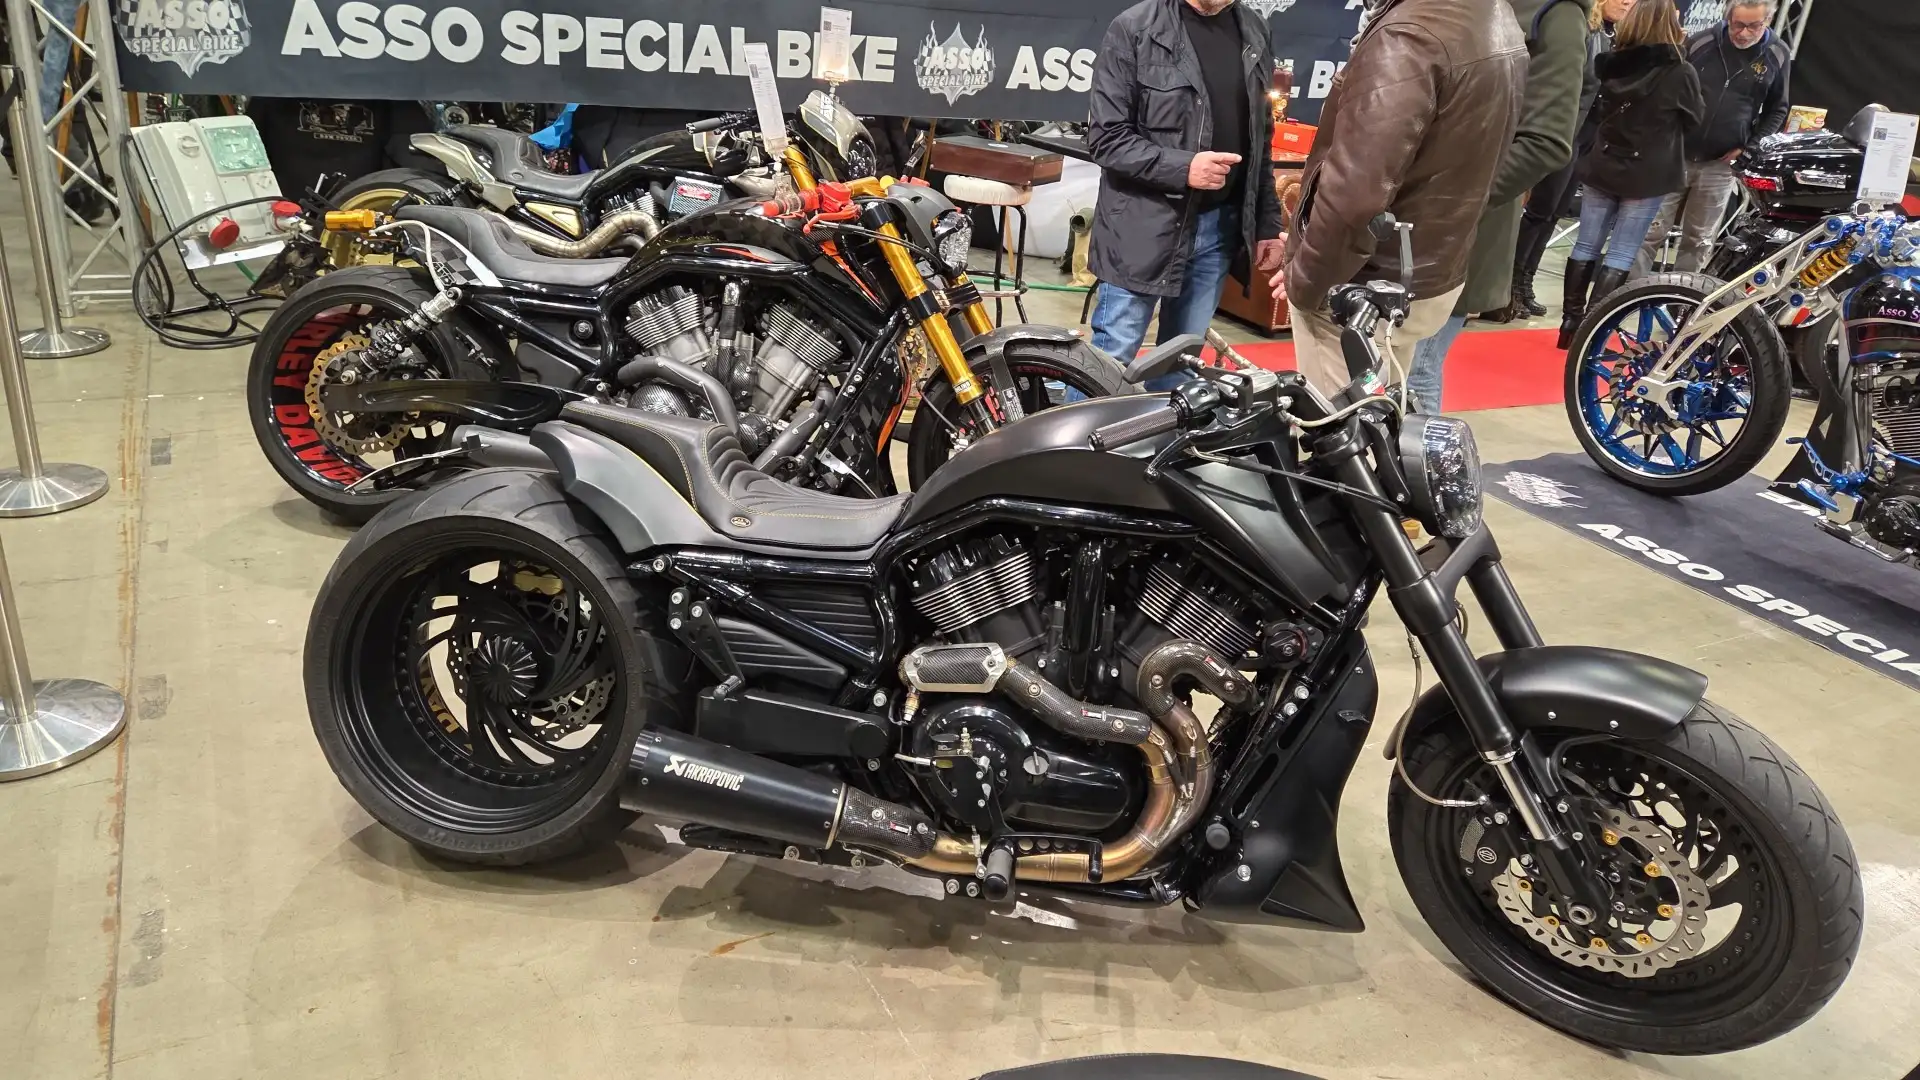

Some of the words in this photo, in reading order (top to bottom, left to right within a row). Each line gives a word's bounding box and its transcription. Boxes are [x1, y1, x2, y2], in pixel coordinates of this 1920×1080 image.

[134, 0, 229, 29] ASSO
[132, 36, 199, 53] SPECIAL
[203, 34, 241, 50] BIKE
[281, 0, 484, 63] ASSO
[500, 10, 752, 76] SPECIAL
[928, 46, 986, 70] ASSO
[921, 74, 962, 87] SPECIAL
[964, 73, 988, 86] BIKE
[1877, 306, 1907, 317] Asso
[1577, 523, 1725, 581] ASSO
